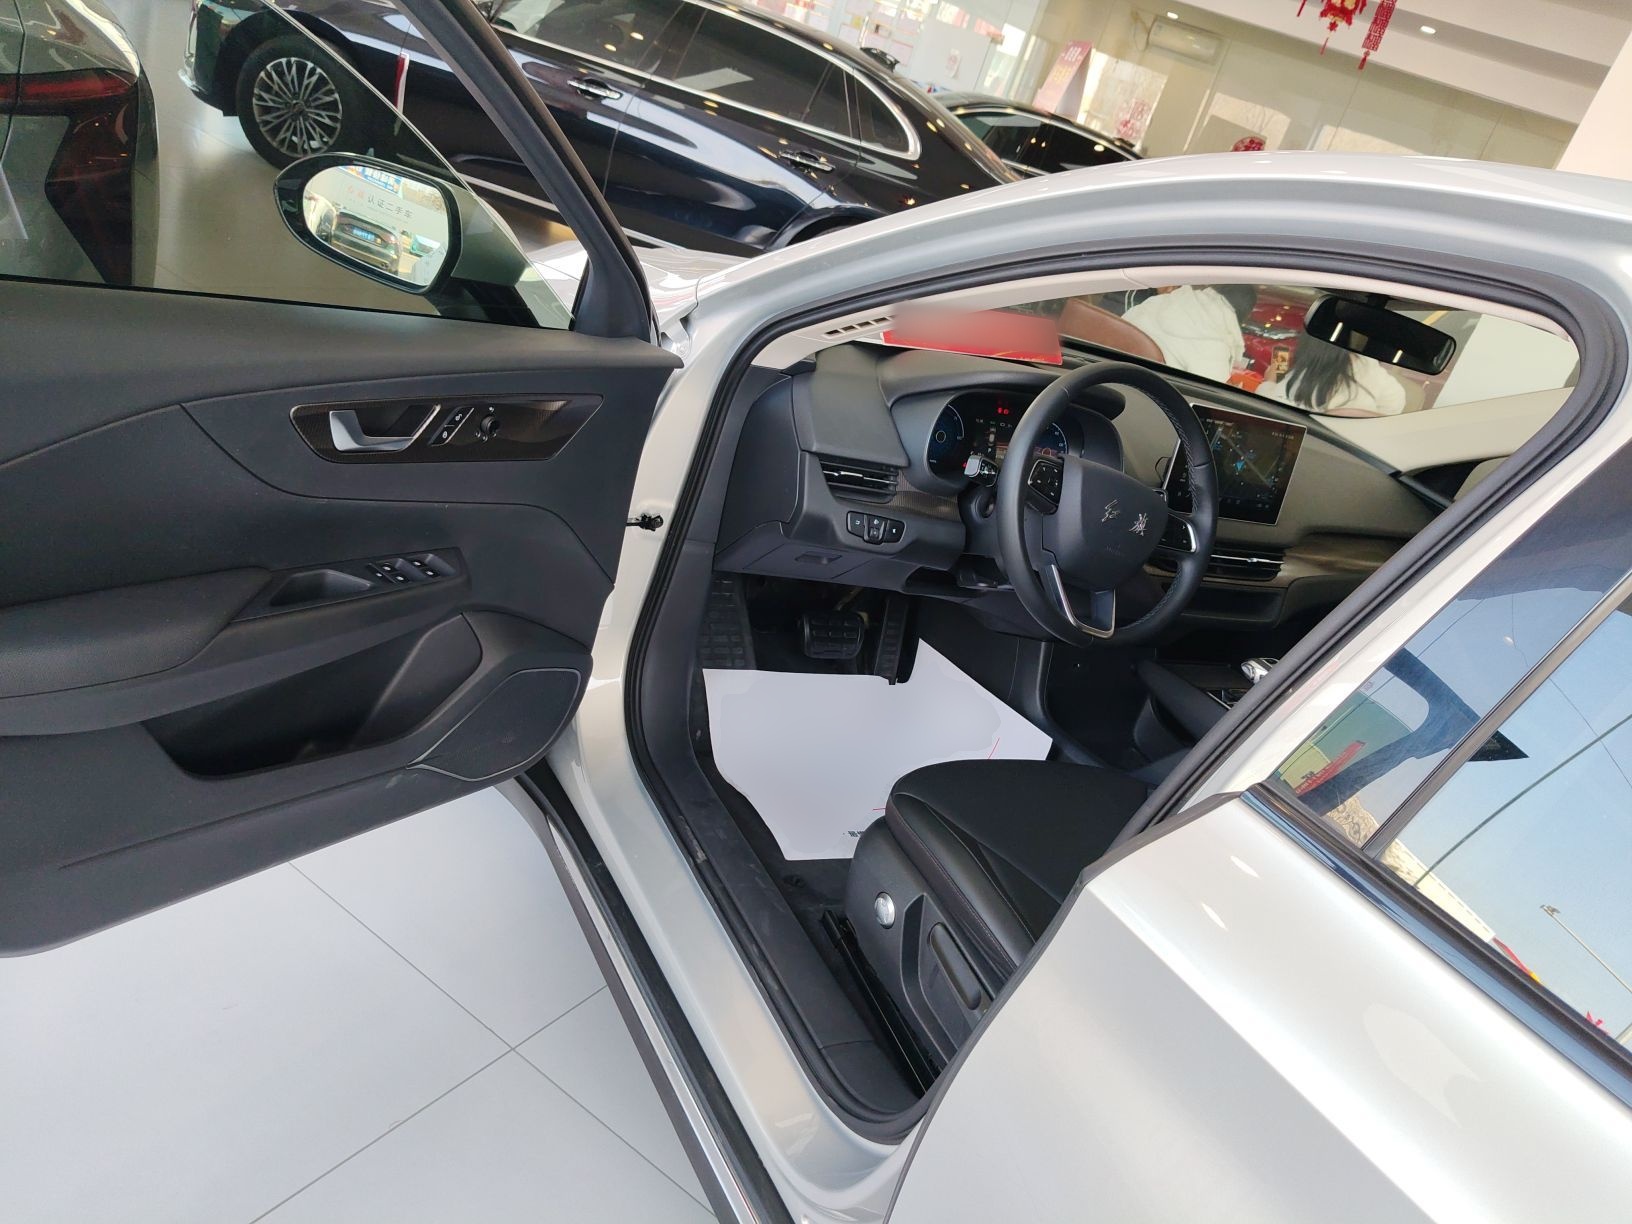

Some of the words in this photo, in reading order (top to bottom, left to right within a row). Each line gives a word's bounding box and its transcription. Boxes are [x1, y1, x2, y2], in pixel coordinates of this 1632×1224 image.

[368, 193, 412, 218] 认证二手车
